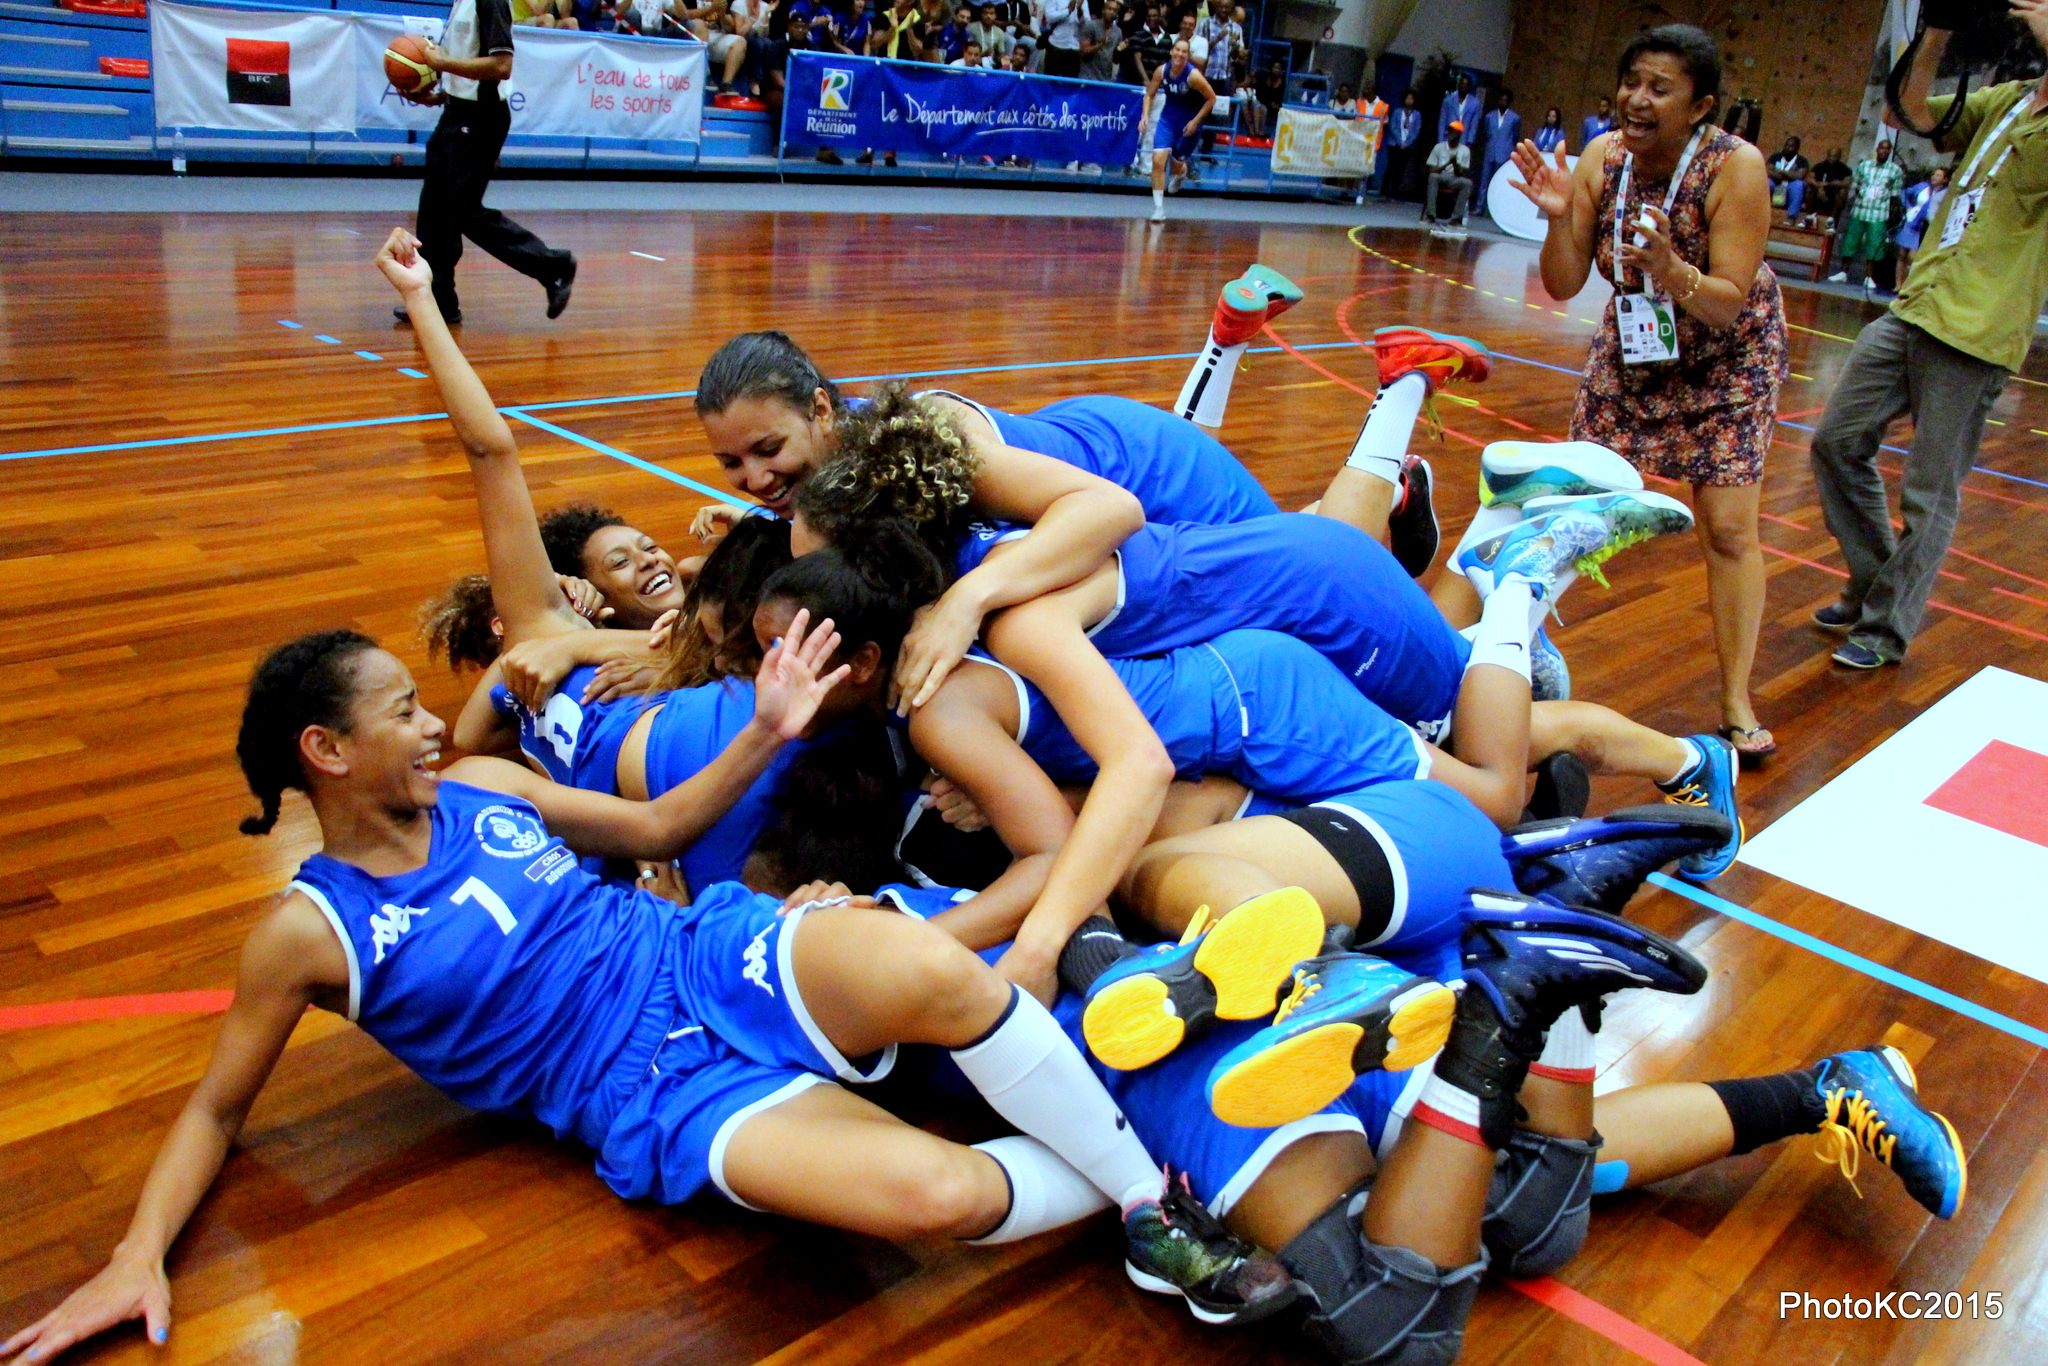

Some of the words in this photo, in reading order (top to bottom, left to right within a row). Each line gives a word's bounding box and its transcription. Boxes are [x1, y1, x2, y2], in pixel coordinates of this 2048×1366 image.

[248, 75, 271, 84] BFC
[577, 63, 625, 87] L'eau
[633, 67, 652, 88] de
[658, 69, 690, 90] tous
[590, 87, 615, 110] les
[622, 94, 672, 117] sports
[806, 116, 857, 134] Réunion
[881, 91, 899, 122] Le
[904, 92, 996, 139] Département
[996, 108, 1019, 125] aux
[1022, 103, 1057, 129] côtés
[1059, 101, 1078, 129] des
[1080, 104, 1127, 141] sportifs
[1660, 323, 1672, 336] D
[541, 851, 562, 867] CROS
[450, 876, 518, 935] 7
